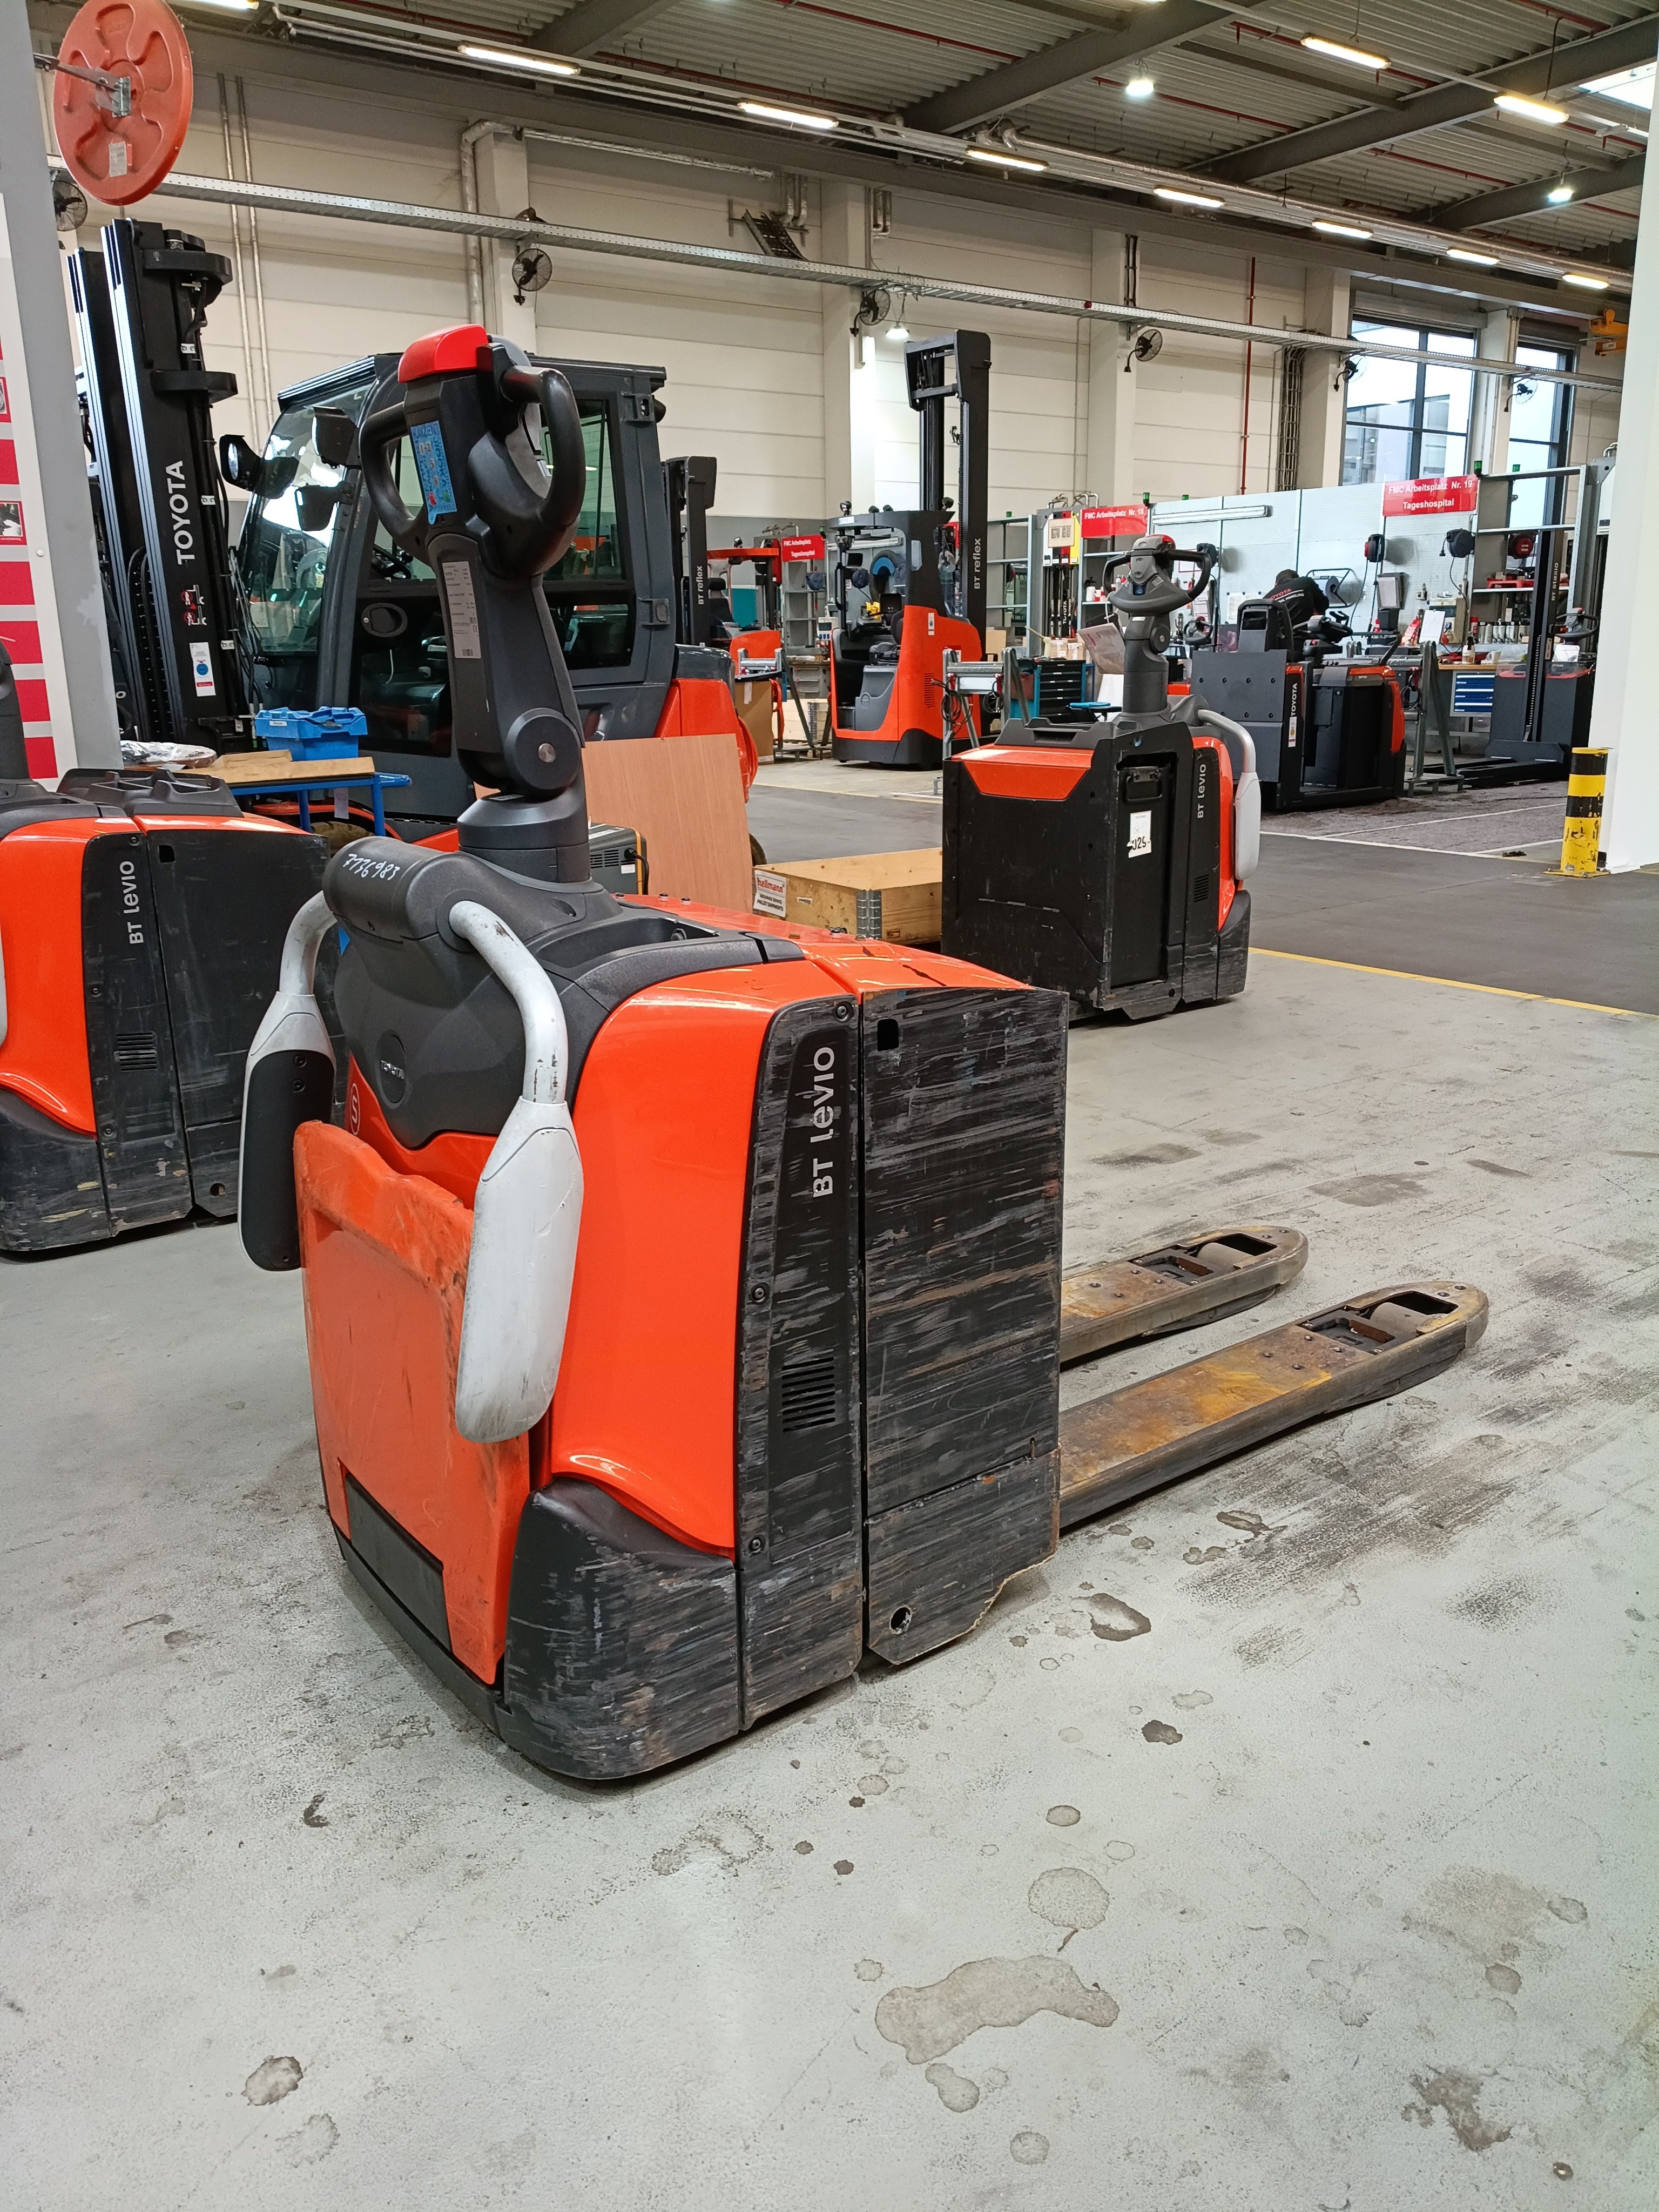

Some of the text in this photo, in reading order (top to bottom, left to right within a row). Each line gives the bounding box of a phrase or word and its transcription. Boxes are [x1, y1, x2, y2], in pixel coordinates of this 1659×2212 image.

[1388, 480, 1473, 494] FMC Arbeitsplatz Nr. 19
[1402, 498, 1454, 511] Tageshospital
[165, 460, 195, 565] TOYOTA
[1096, 510, 1127, 518] Arbeitsplatz
[973, 538, 981, 589] BT reflex
[698, 594, 704, 605] BT
[1269, 588, 1292, 601] OYOTA
[1197, 803, 1204, 818] BT
[757, 877, 783, 893] hellmann
[127, 921, 144, 944] BT
[352, 1095, 358, 1124] S
[813, 1157, 833, 1198] BT
